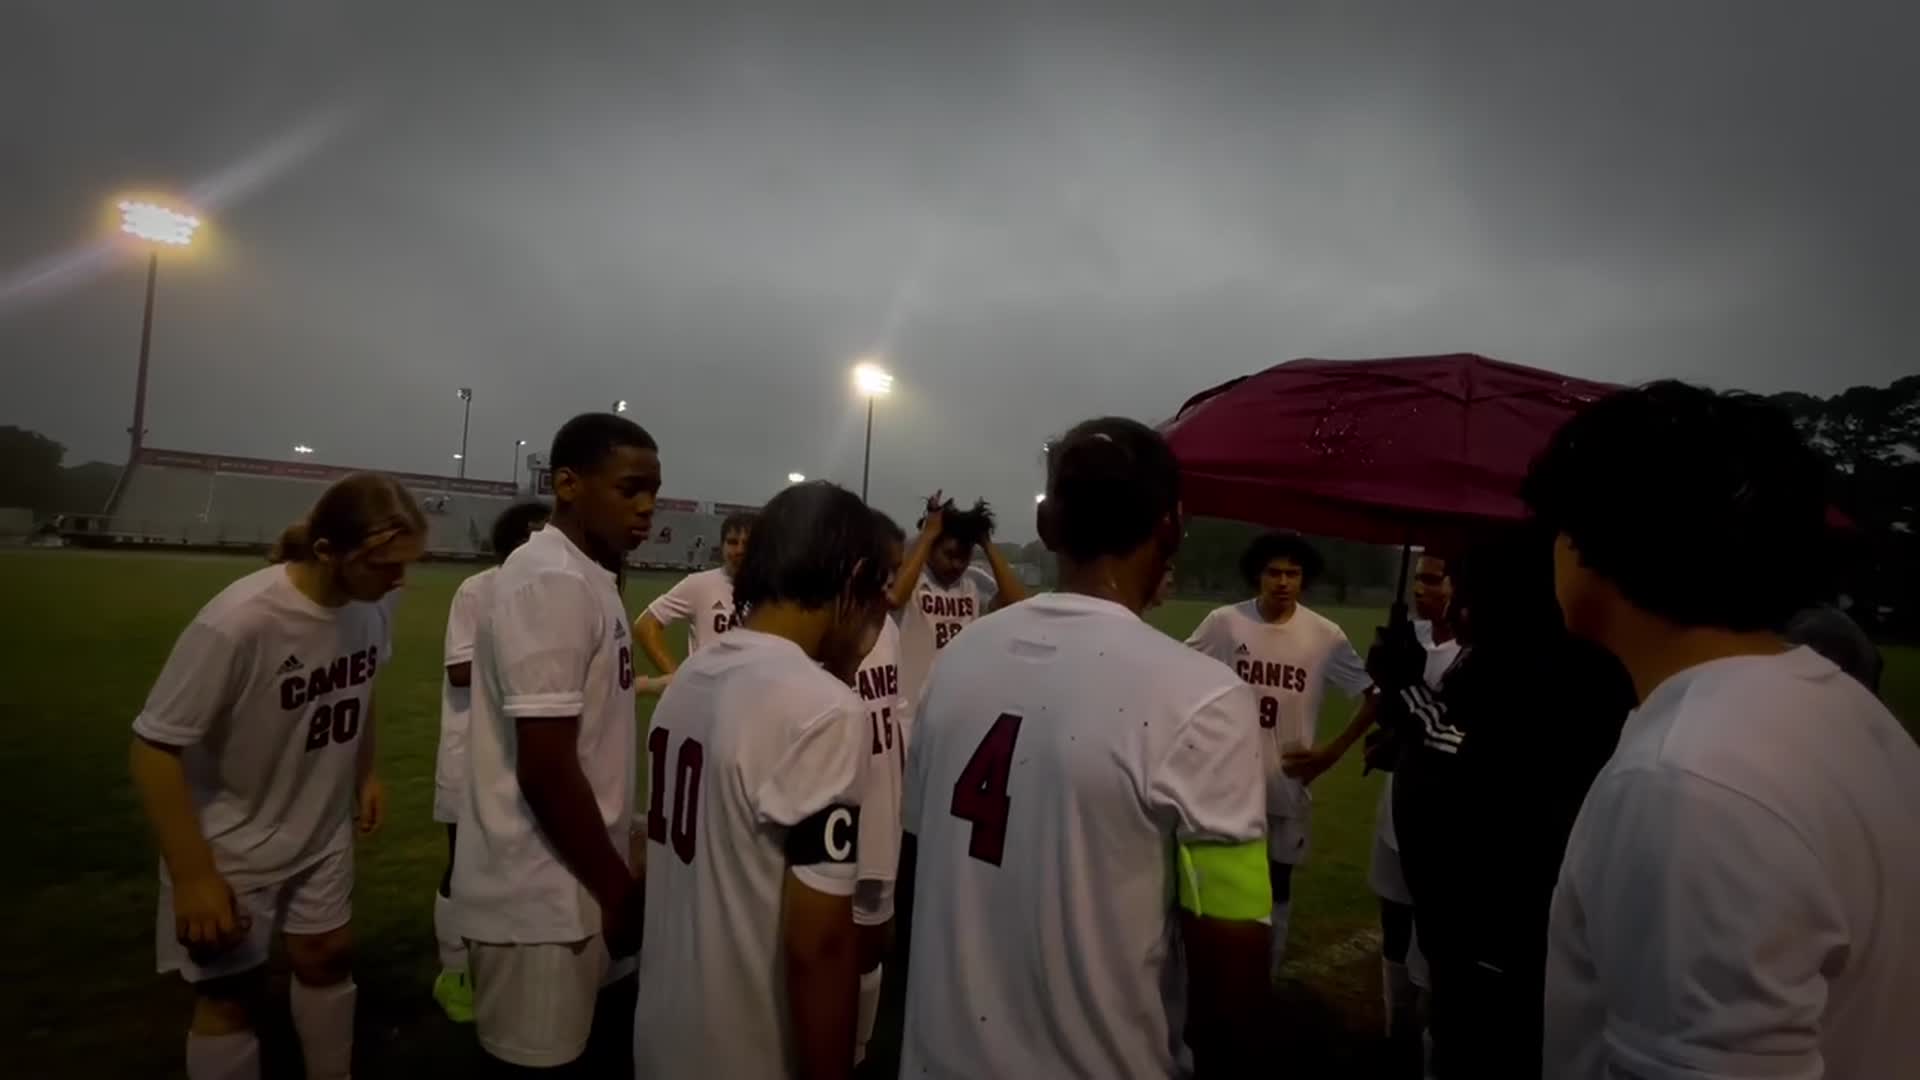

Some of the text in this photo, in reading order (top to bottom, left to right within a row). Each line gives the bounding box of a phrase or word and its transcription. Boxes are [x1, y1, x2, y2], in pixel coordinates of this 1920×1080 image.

[922, 595, 973, 617] CANES
[1236, 659, 1306, 692] CANES
[306, 698, 359, 752] 20
[871, 707, 893, 755] 16
[1259, 696, 1278, 729] 9
[648, 726, 702, 865] 10
[951, 713, 1023, 867] 4
[824, 807, 852, 862] C
